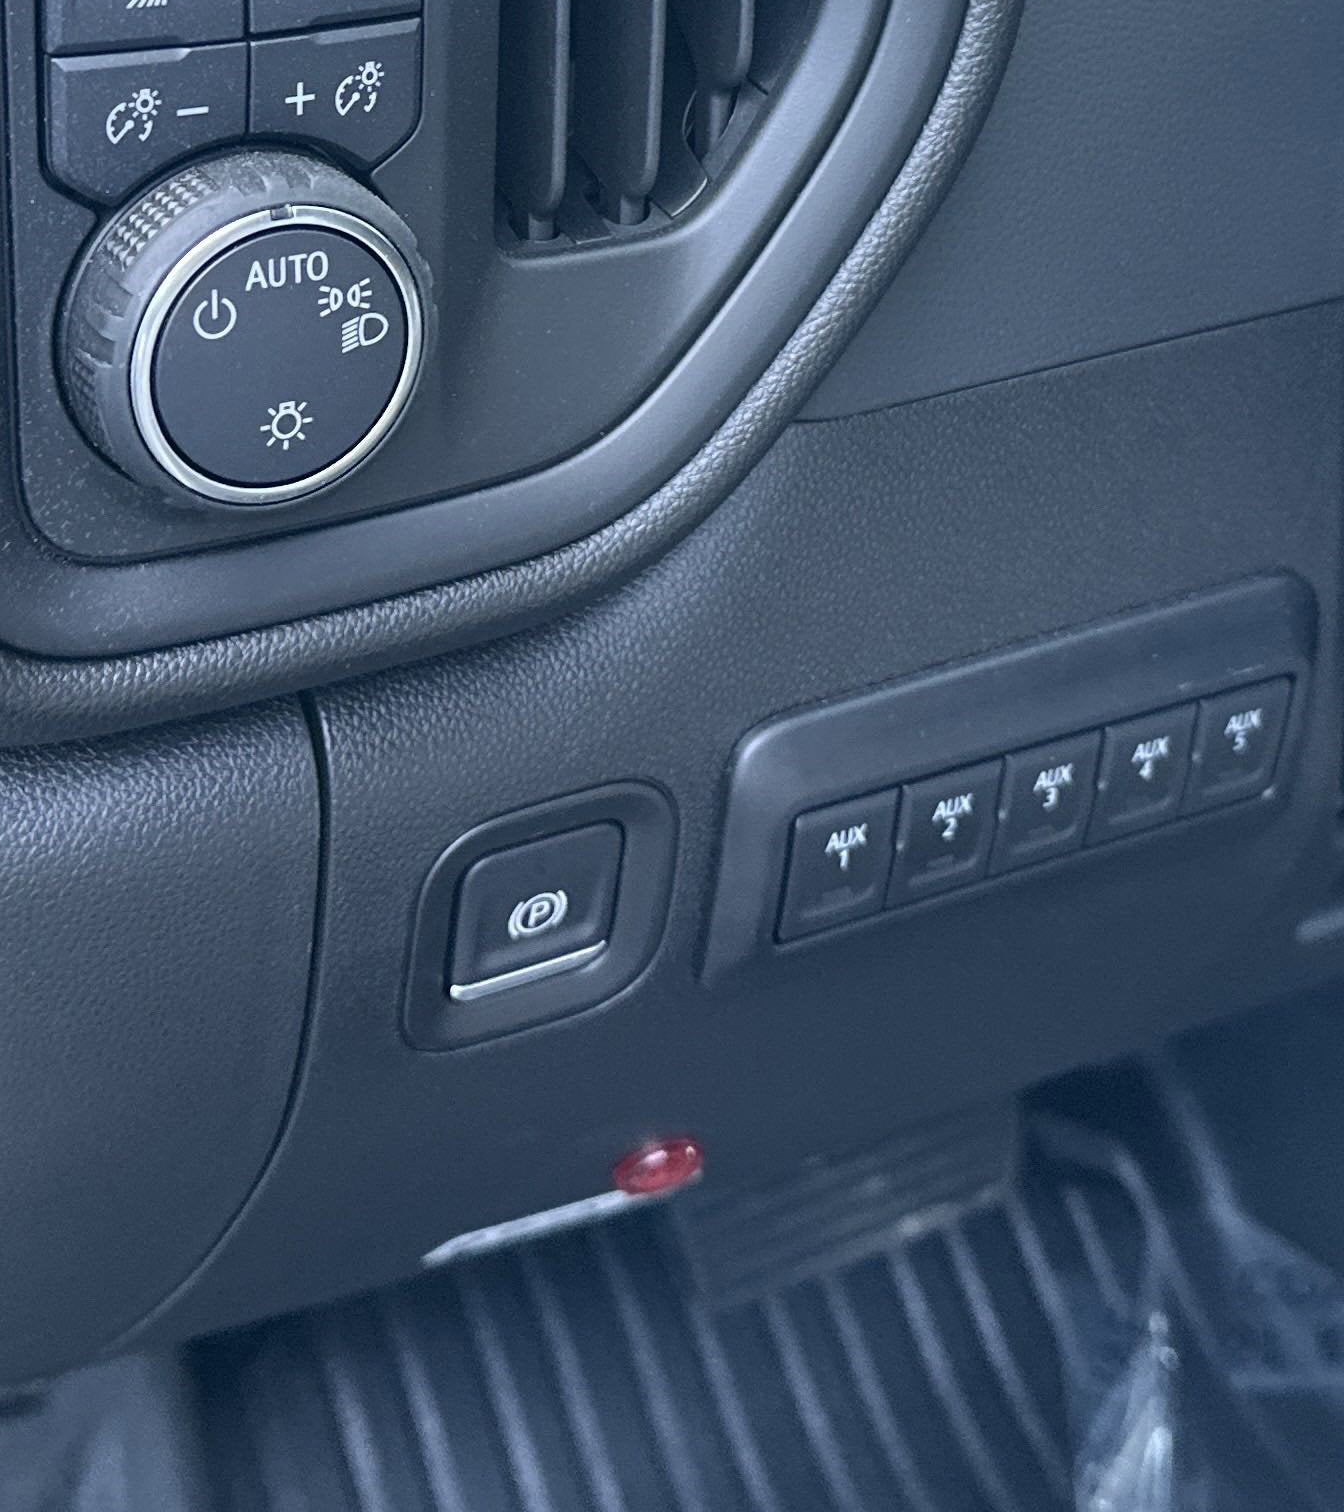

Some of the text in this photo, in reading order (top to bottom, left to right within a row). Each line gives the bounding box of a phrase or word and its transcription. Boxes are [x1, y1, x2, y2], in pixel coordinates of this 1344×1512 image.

[245, 250, 329, 291] AUTO
[1223, 708, 1264, 736] AUX
[1131, 736, 1171, 765] AUX
[1232, 729, 1247, 752] 5
[1033, 763, 1074, 793] AUX
[1138, 758, 1155, 780] 4
[932, 793, 973, 823] AUX
[1042, 785, 1059, 809] 3
[824, 822, 868, 854] AUX
[941, 815, 958, 839] 2
[838, 848, 851, 871] 1
